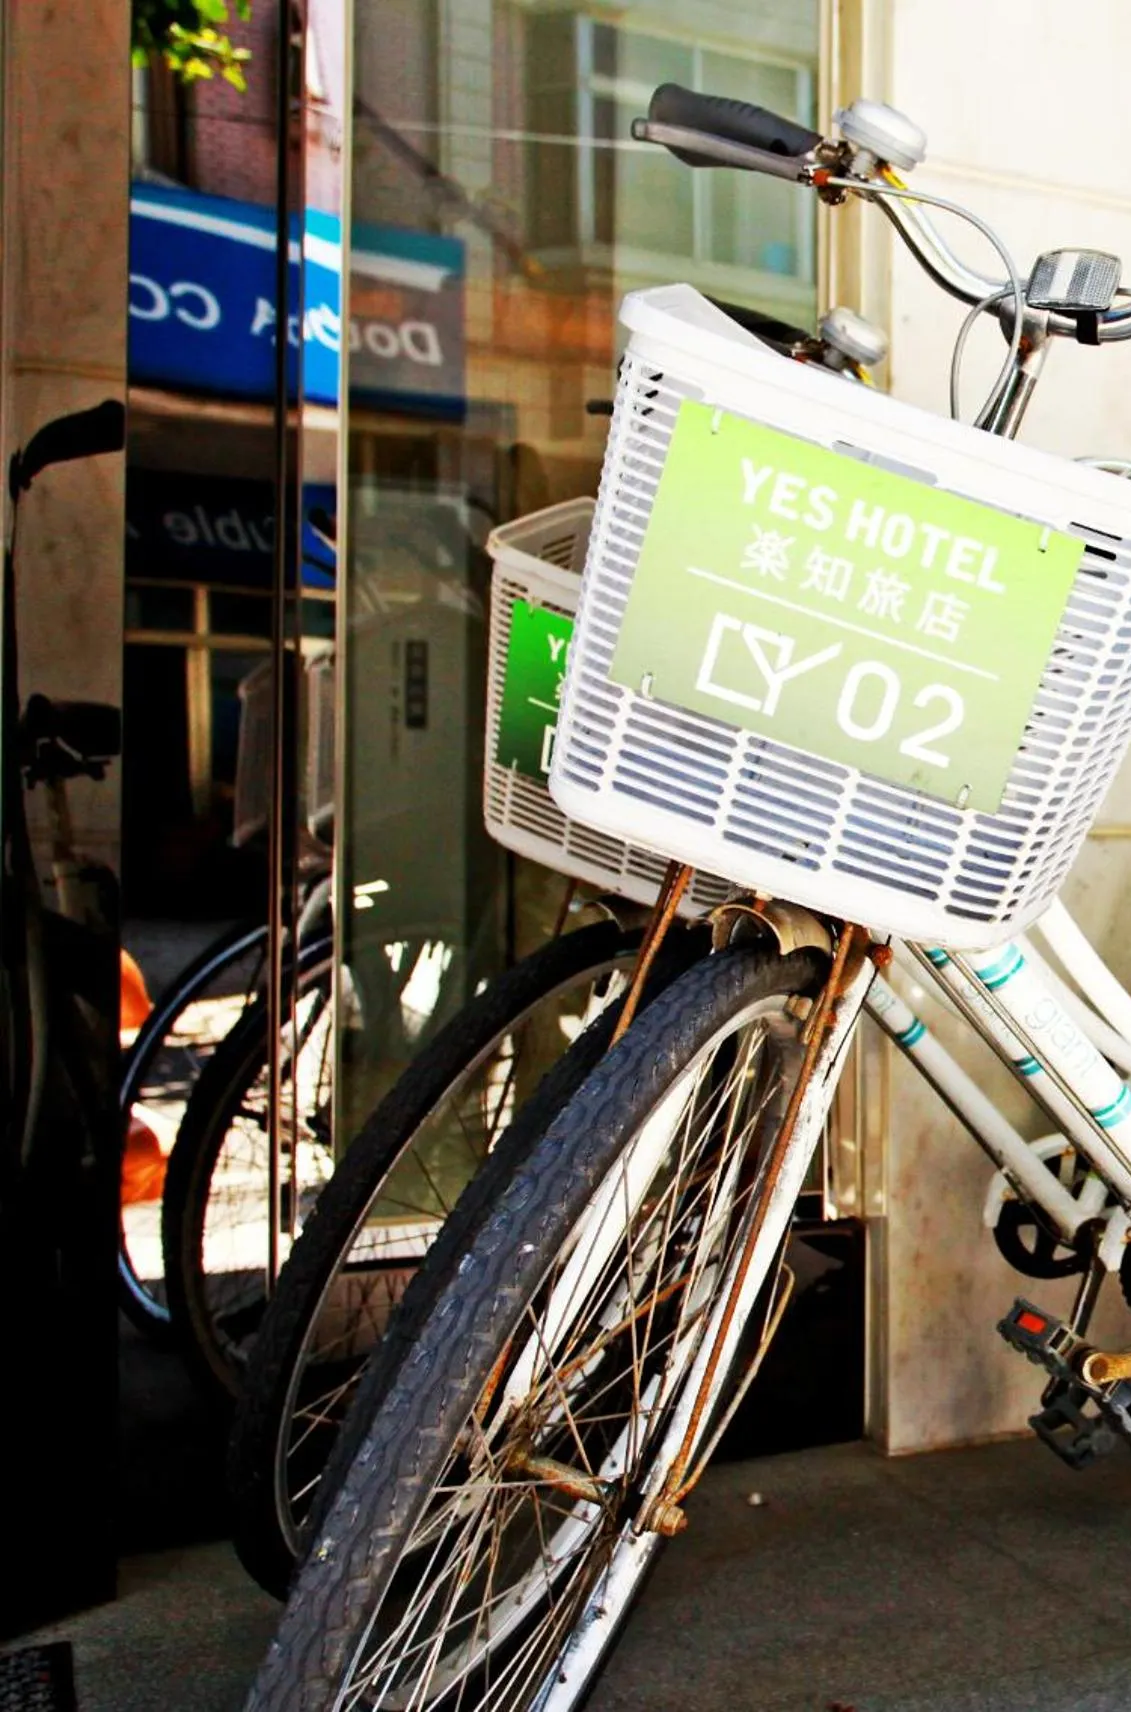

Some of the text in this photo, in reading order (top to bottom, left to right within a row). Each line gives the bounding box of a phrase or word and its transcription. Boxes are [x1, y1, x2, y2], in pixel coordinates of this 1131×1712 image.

[740, 457, 1006, 595] YES HOTEL
[835, 660, 966, 769] 02
